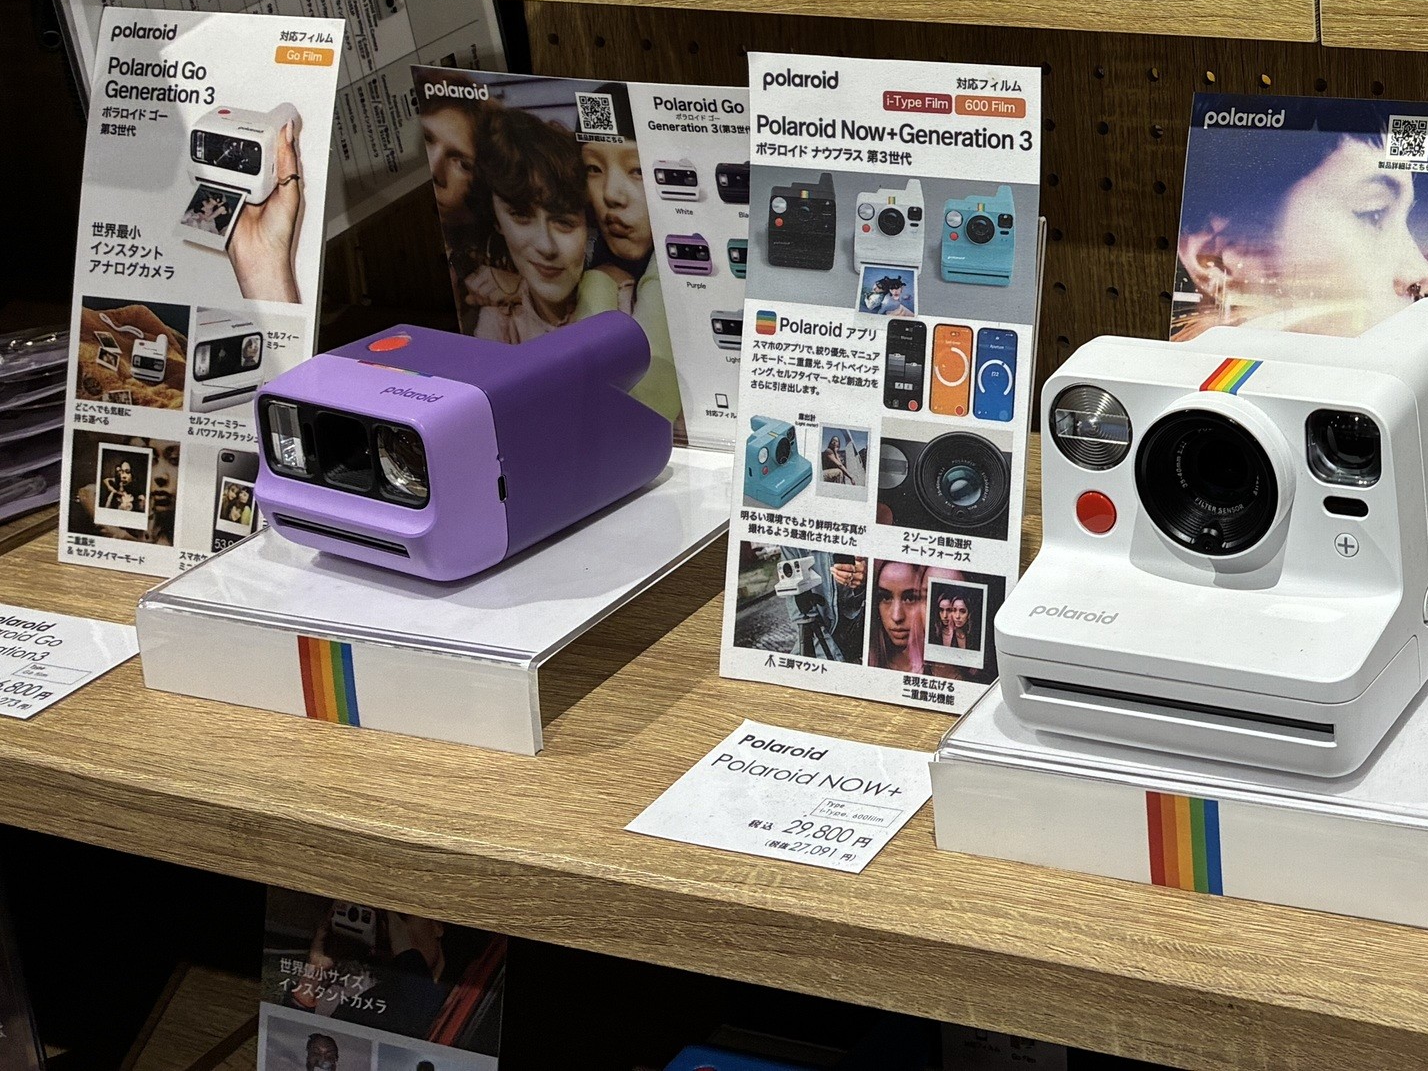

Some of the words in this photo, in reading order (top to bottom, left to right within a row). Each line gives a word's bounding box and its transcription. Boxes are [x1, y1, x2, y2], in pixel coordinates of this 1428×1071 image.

[110, 24, 178, 42] polaroid
[279, 31, 334, 44] 対応フィルム
[286, 50, 301, 61] Go
[302, 51, 322, 62] Film
[108, 57, 178, 79] Polaroid
[181, 61, 207, 81] Go
[763, 69, 839, 91] polaroid
[956, 78, 1022, 92] 対応フィルム
[105, 80, 200, 103] Generation
[203, 87, 215, 105] 3
[425, 80, 489, 101] polaroid
[653, 96, 718, 113] Polaroid
[721, 99, 744, 113] Go
[886, 94, 922, 109] i-Type
[925, 98, 949, 110] Film
[965, 99, 988, 112] 600
[991, 101, 1015, 113] Film
[101, 107, 146, 121] ポラロイド
[149, 109, 168, 120] ゴー
[1203, 109, 1286, 129] polaroid
[100, 123, 136, 137] 第3世代
[648, 121, 708, 133] Generation
[756, 114, 836, 138] Polaroid
[1019, 131, 1032, 151] 3
[756, 143, 808, 158] ポラロイド
[812, 146, 864, 162] ナウプラス
[867, 150, 912, 166] 第3世代
[91, 222, 141, 239] 世界最小
[90, 242, 163, 258] インスタント
[89, 260, 175, 279] アナログカメラ
[687, 281, 706, 290] Purple
[267, 331, 299, 341] セルフィー
[779, 317, 842, 338] Polaroid
[845, 328, 877, 341] アプリ
[266, 341, 286, 350] ミラー
[381, 386, 444, 404] polaroid
[751, 380, 820, 396] さらに引き出します。
[188, 416, 246, 429] セルフィーミラー
[901, 545, 972, 563] オートフォーカス
[1028, 604, 1118, 626] polaroid
[35, 635, 62, 647] Go
[777, 657, 828, 673] 三脚マウント
[903, 675, 955, 692] 表現を広げる
[902, 689, 955, 706] 二重露光機能
[738, 734, 829, 762] Polaroid
[711, 753, 819, 786] Polaroid
[818, 774, 903, 797] NOW+
[825, 801, 845, 809] Type
[853, 814, 884, 823] 600film
[781, 820, 854, 844] 29,800
[852, 836, 873, 848] 円
[279, 958, 363, 990] 世界最小サイズ
[279, 979, 387, 1014] インスタントカメラ
